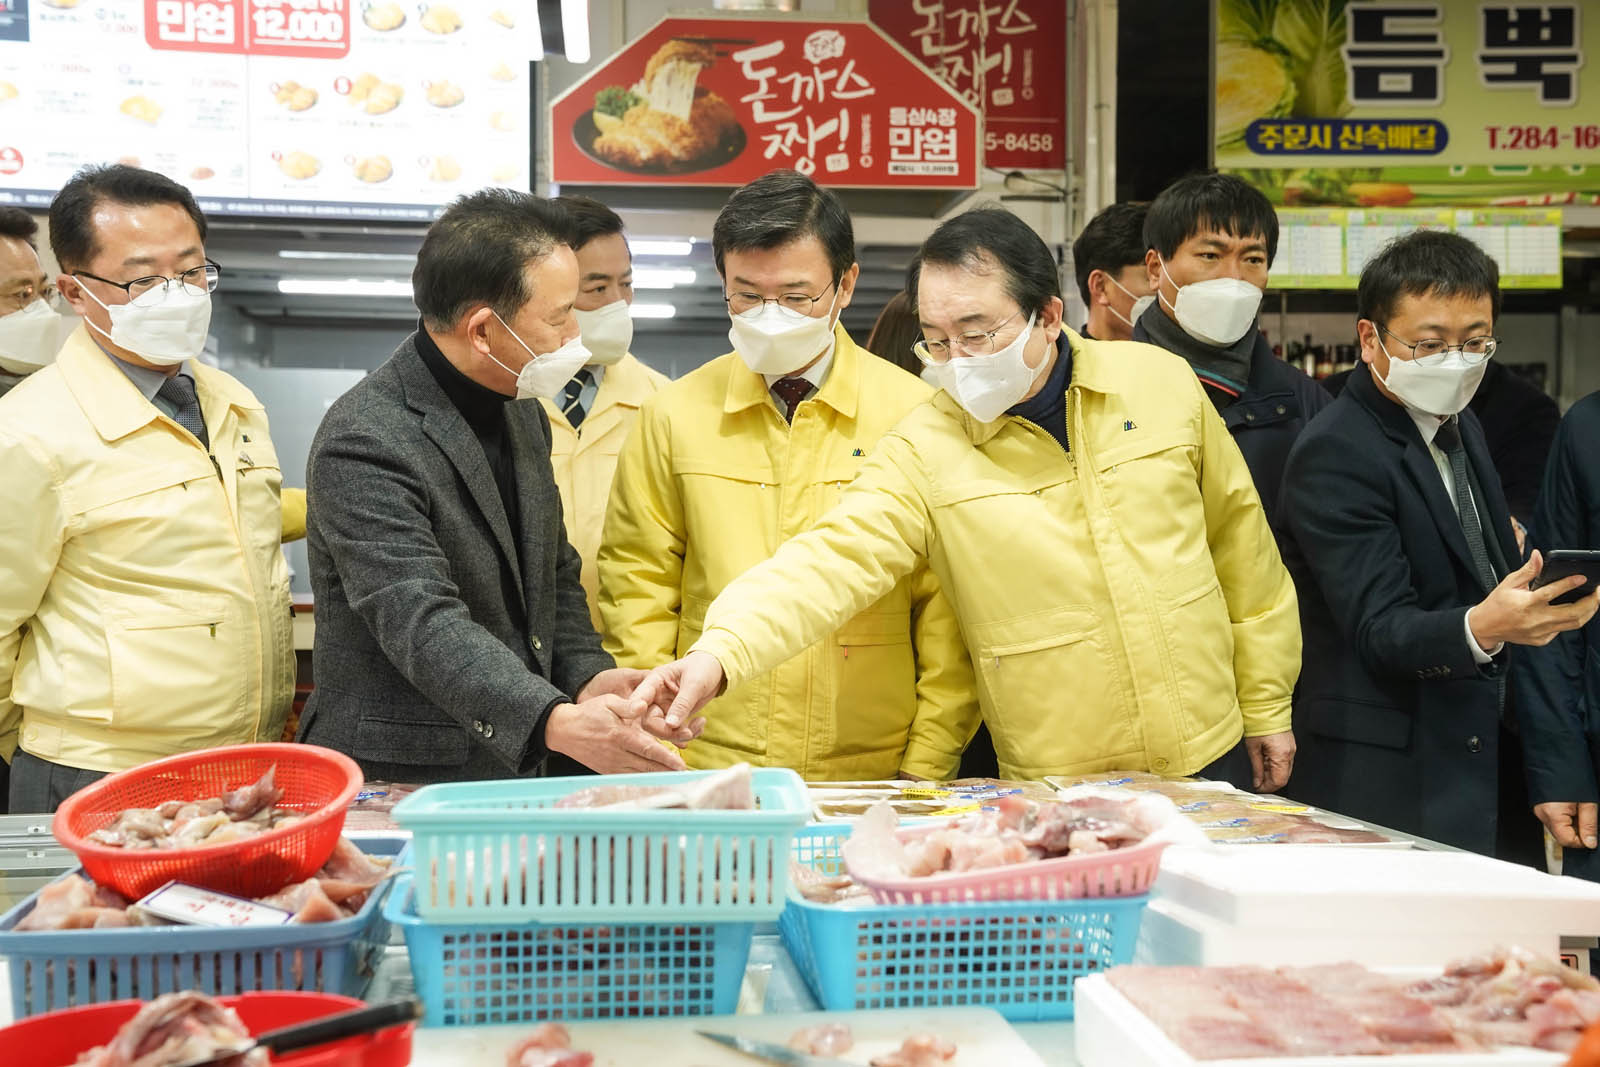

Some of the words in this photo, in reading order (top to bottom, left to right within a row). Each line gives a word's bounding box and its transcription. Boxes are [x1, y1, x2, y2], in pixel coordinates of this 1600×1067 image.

[252, 8, 344, 41] 12,000
[732, 39, 876, 124] 돈까스
[761, 108, 850, 176] 짱!
[889, 127, 957, 161] 만원
[1258, 124, 1332, 150] 주문시
[1339, 124, 1437, 150] 신속배달
